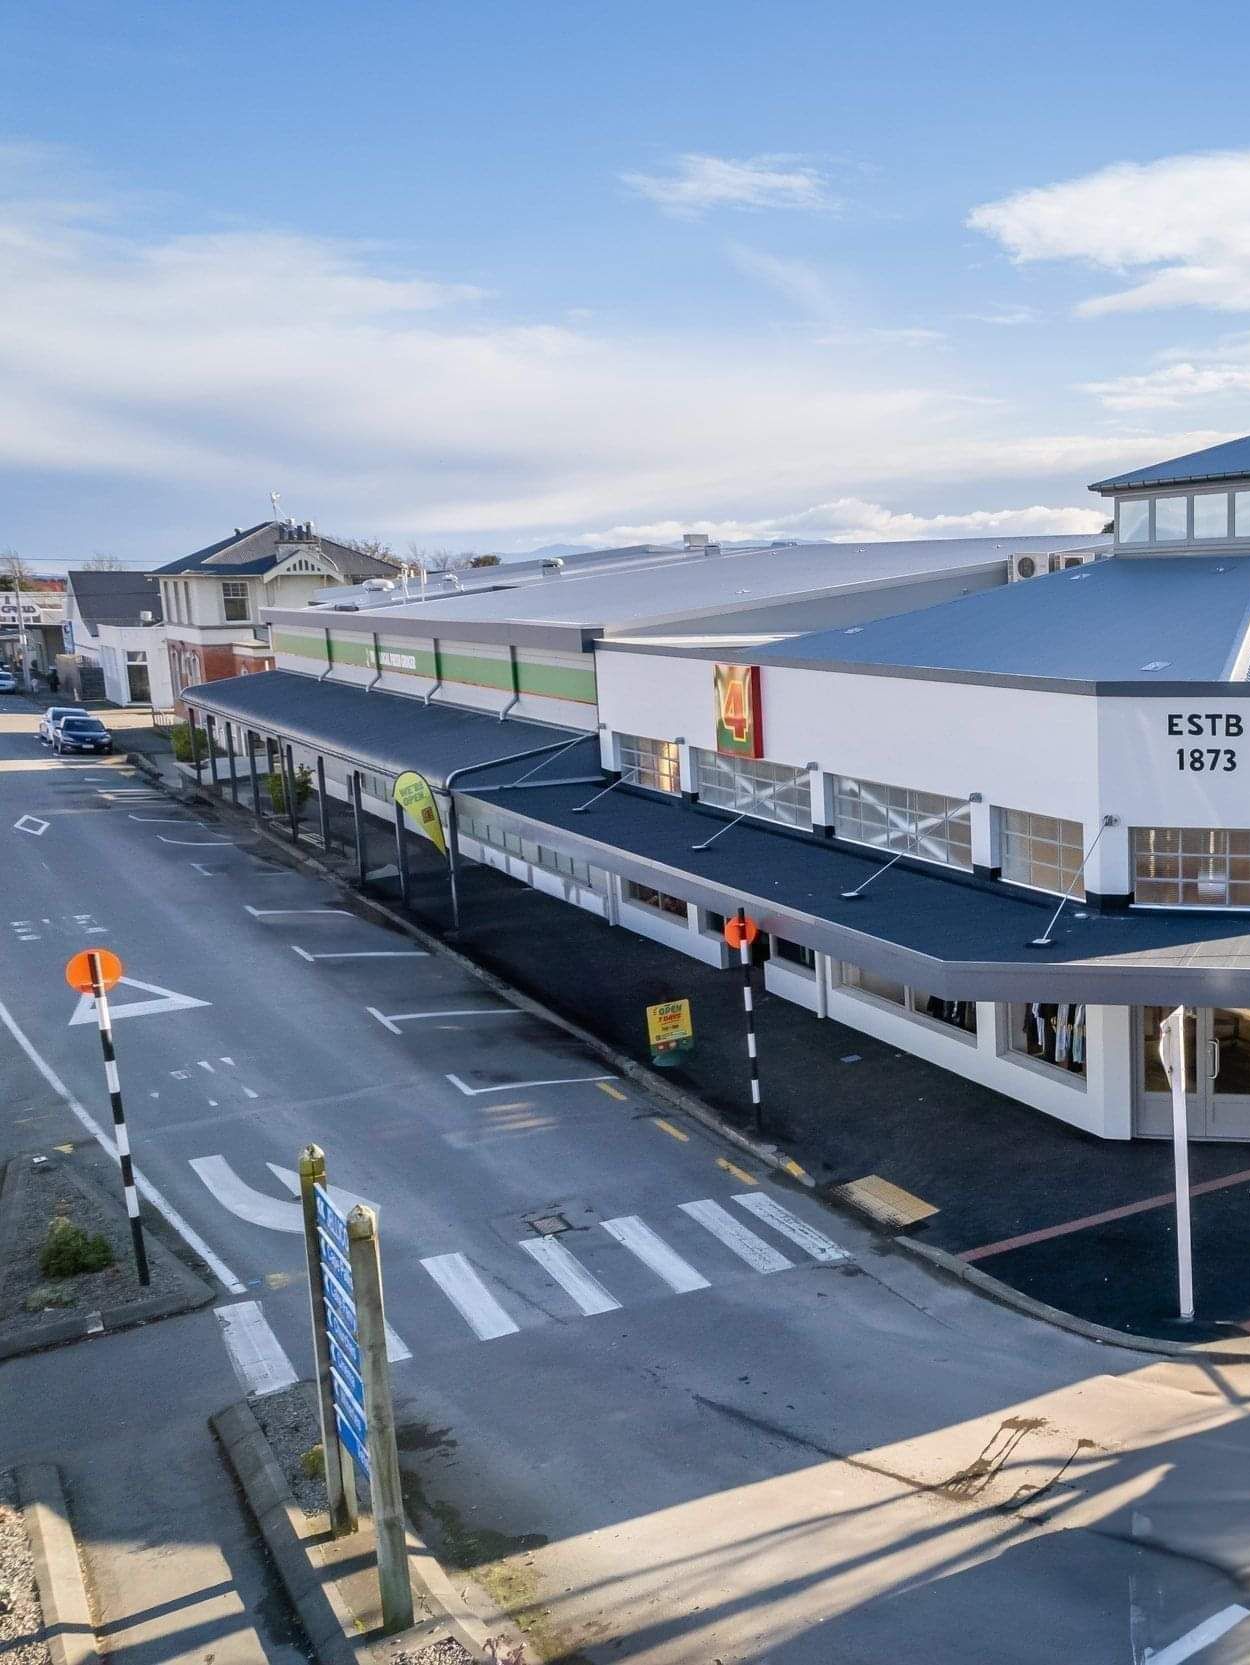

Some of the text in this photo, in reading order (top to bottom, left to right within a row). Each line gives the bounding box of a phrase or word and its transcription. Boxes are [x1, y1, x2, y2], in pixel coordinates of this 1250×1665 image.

[722, 680, 749, 742] 4
[1167, 713, 1244, 737] ESTB
[1176, 748, 1237, 772] 1873
